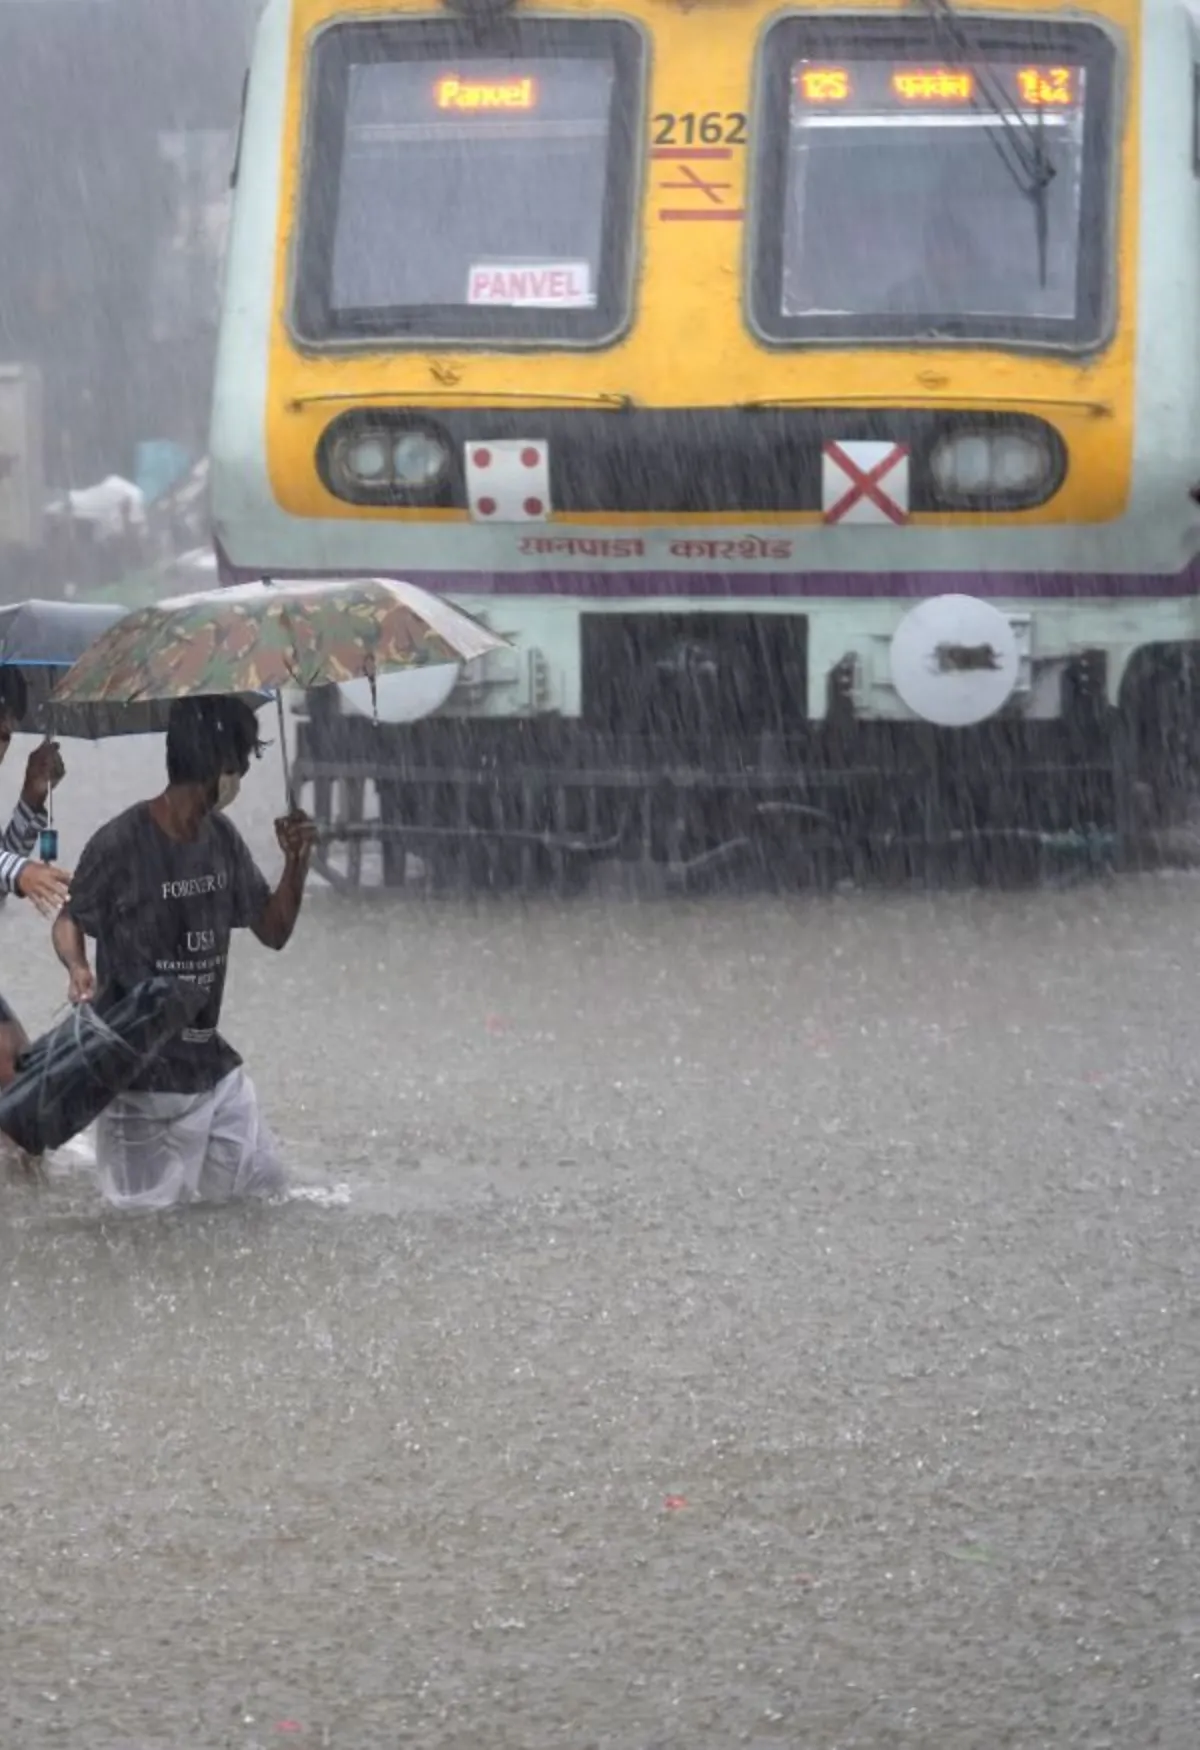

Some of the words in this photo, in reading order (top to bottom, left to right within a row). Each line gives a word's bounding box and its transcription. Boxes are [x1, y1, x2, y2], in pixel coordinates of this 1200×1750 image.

[437, 79, 533, 109] Panvel
[653, 111, 748, 145] 2162
[472, 271, 580, 299] PANVEL
[669, 533, 793, 559] कारशेड
